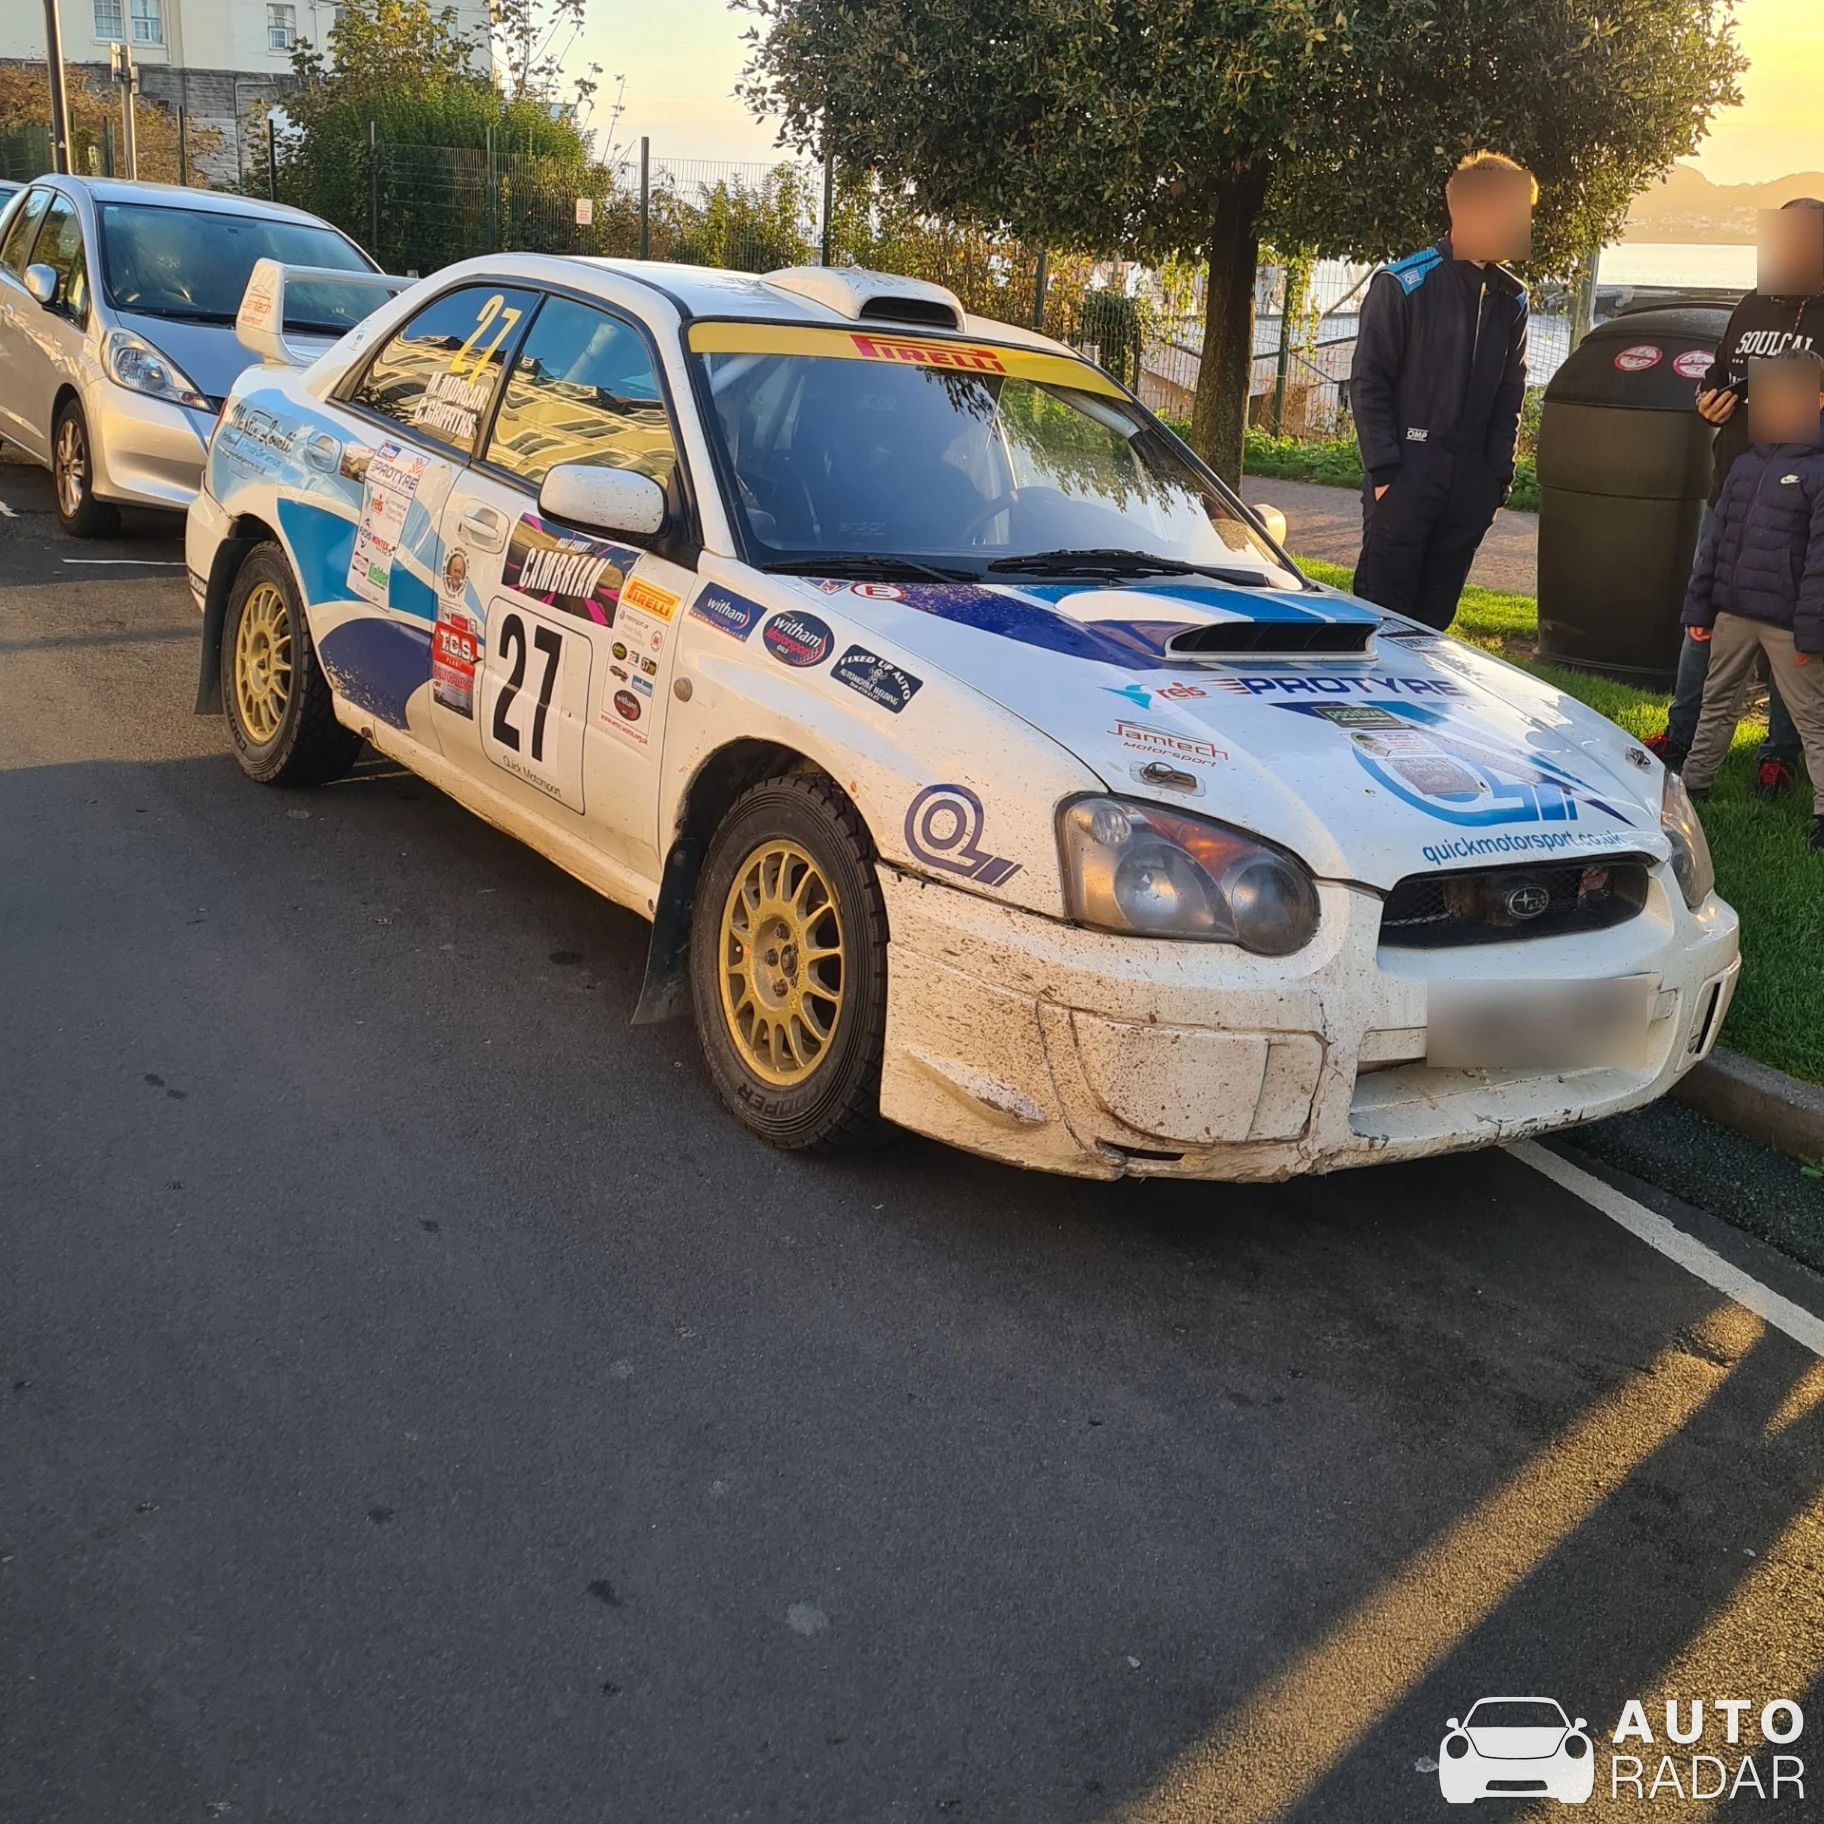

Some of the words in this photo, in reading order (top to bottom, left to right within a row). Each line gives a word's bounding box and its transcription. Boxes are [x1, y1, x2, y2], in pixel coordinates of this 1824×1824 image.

[449, 294, 522, 386] 27
[850, 334, 1007, 373] PIRELLI
[1406, 428, 1428, 442] OMP
[372, 461, 420, 491] PROTYRE
[519, 547, 612, 599] CAMBRIAN
[626, 581, 676, 617] PIRELLI
[706, 597, 746, 624] witham
[765, 627, 814, 656] Motorsport
[774, 616, 822, 648] witham
[493, 613, 563, 762] 27
[839, 668, 874, 691] AUTOMOTIVE
[873, 686, 900, 706] WELDING
[840, 655, 876, 666] FIXED
[877, 659, 894, 671] UP
[892, 671, 911, 701] AUTO
[1155, 682, 1208, 700] reis
[1238, 677, 1470, 697] PROTYRE
[1325, 706, 1387, 721] positive
[1106, 723, 1230, 761] Jamtech
[1123, 741, 1217, 768] Motorsport
[503, 755, 523, 776] Quick
[522, 766, 563, 798] Motorsport
[1422, 829, 1626, 866] quickmotorsport.co.uk
